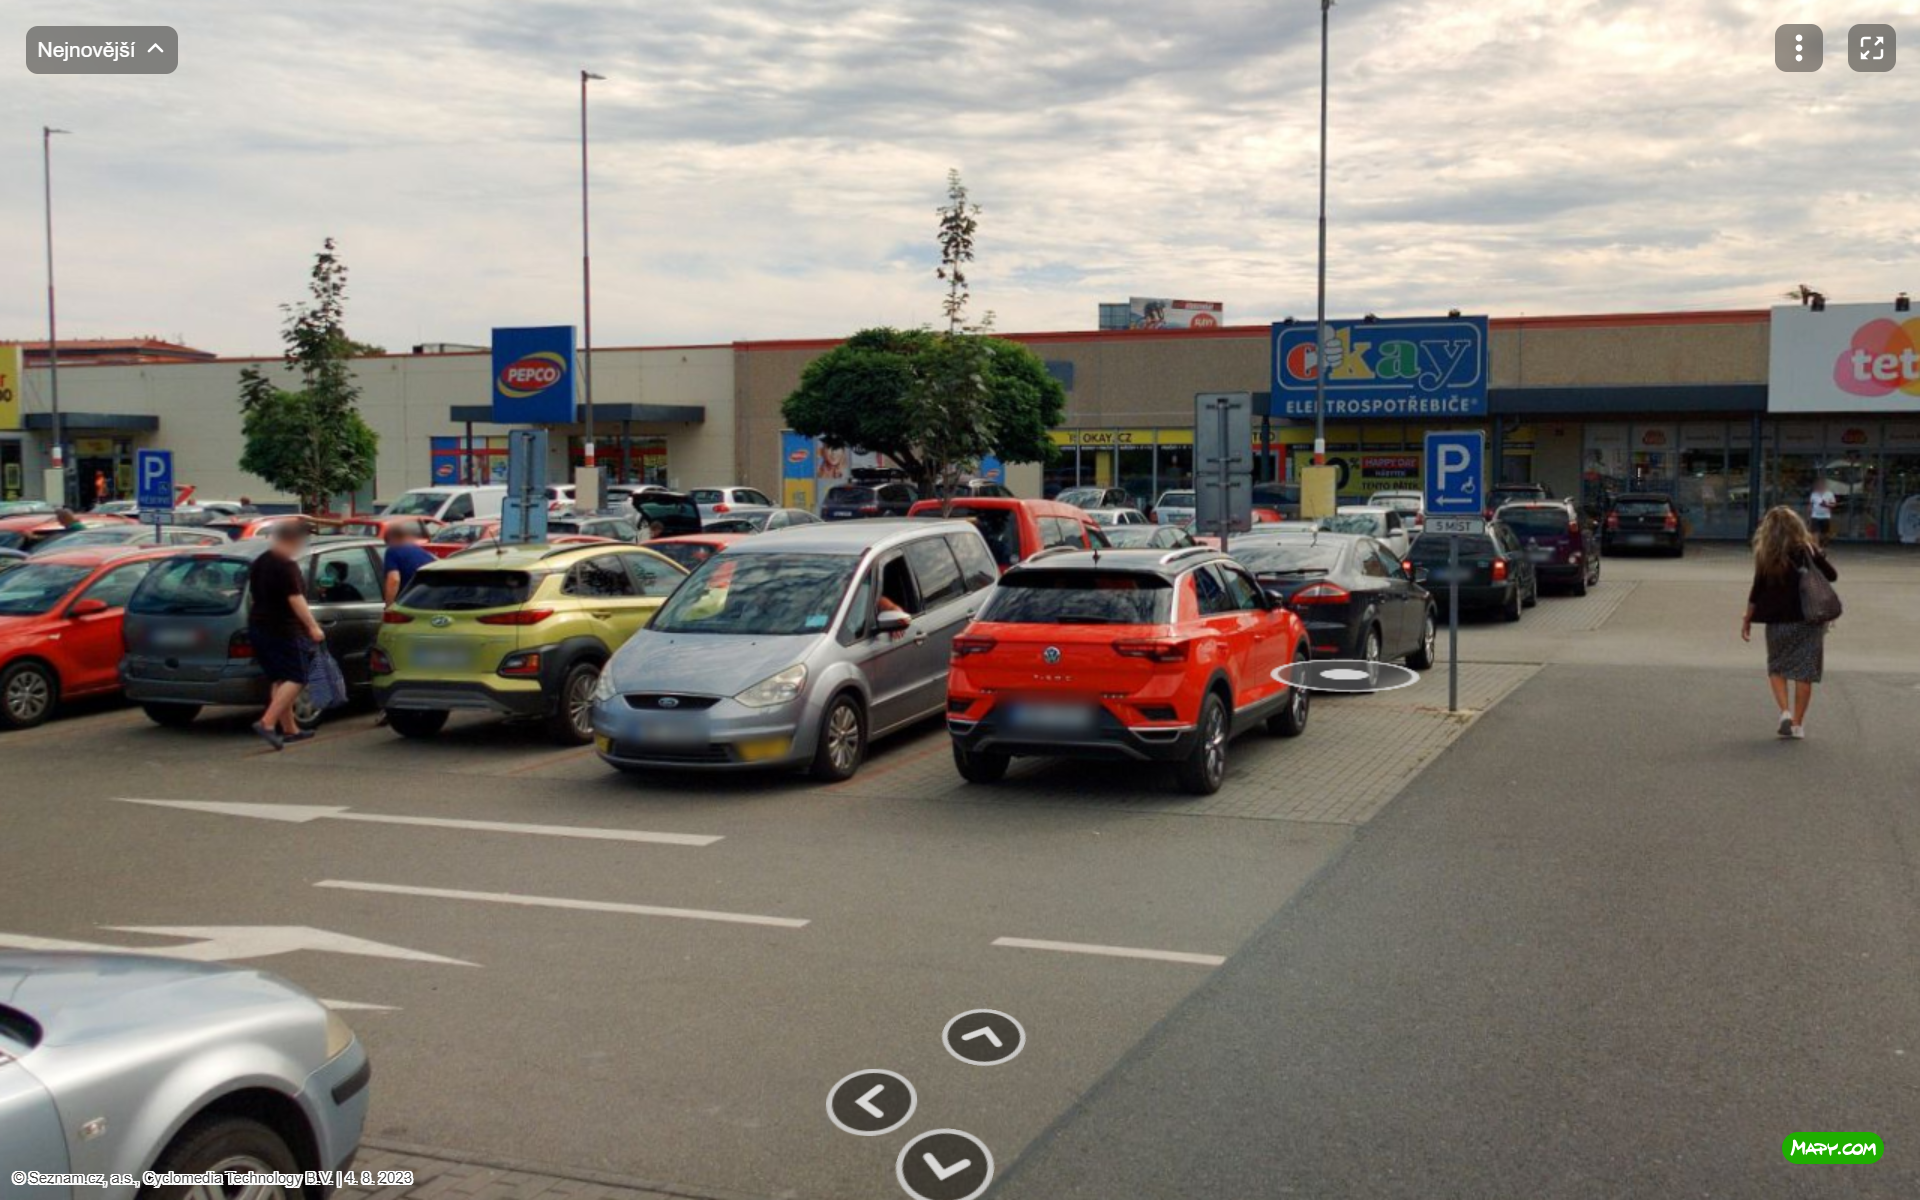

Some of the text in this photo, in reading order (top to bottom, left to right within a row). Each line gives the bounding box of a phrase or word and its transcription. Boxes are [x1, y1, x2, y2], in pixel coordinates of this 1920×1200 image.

[507, 367, 556, 382] PEPCO
[144, 456, 166, 491] P
[1437, 443, 1471, 491] P
[1436, 521, 1472, 531] 5 MST
